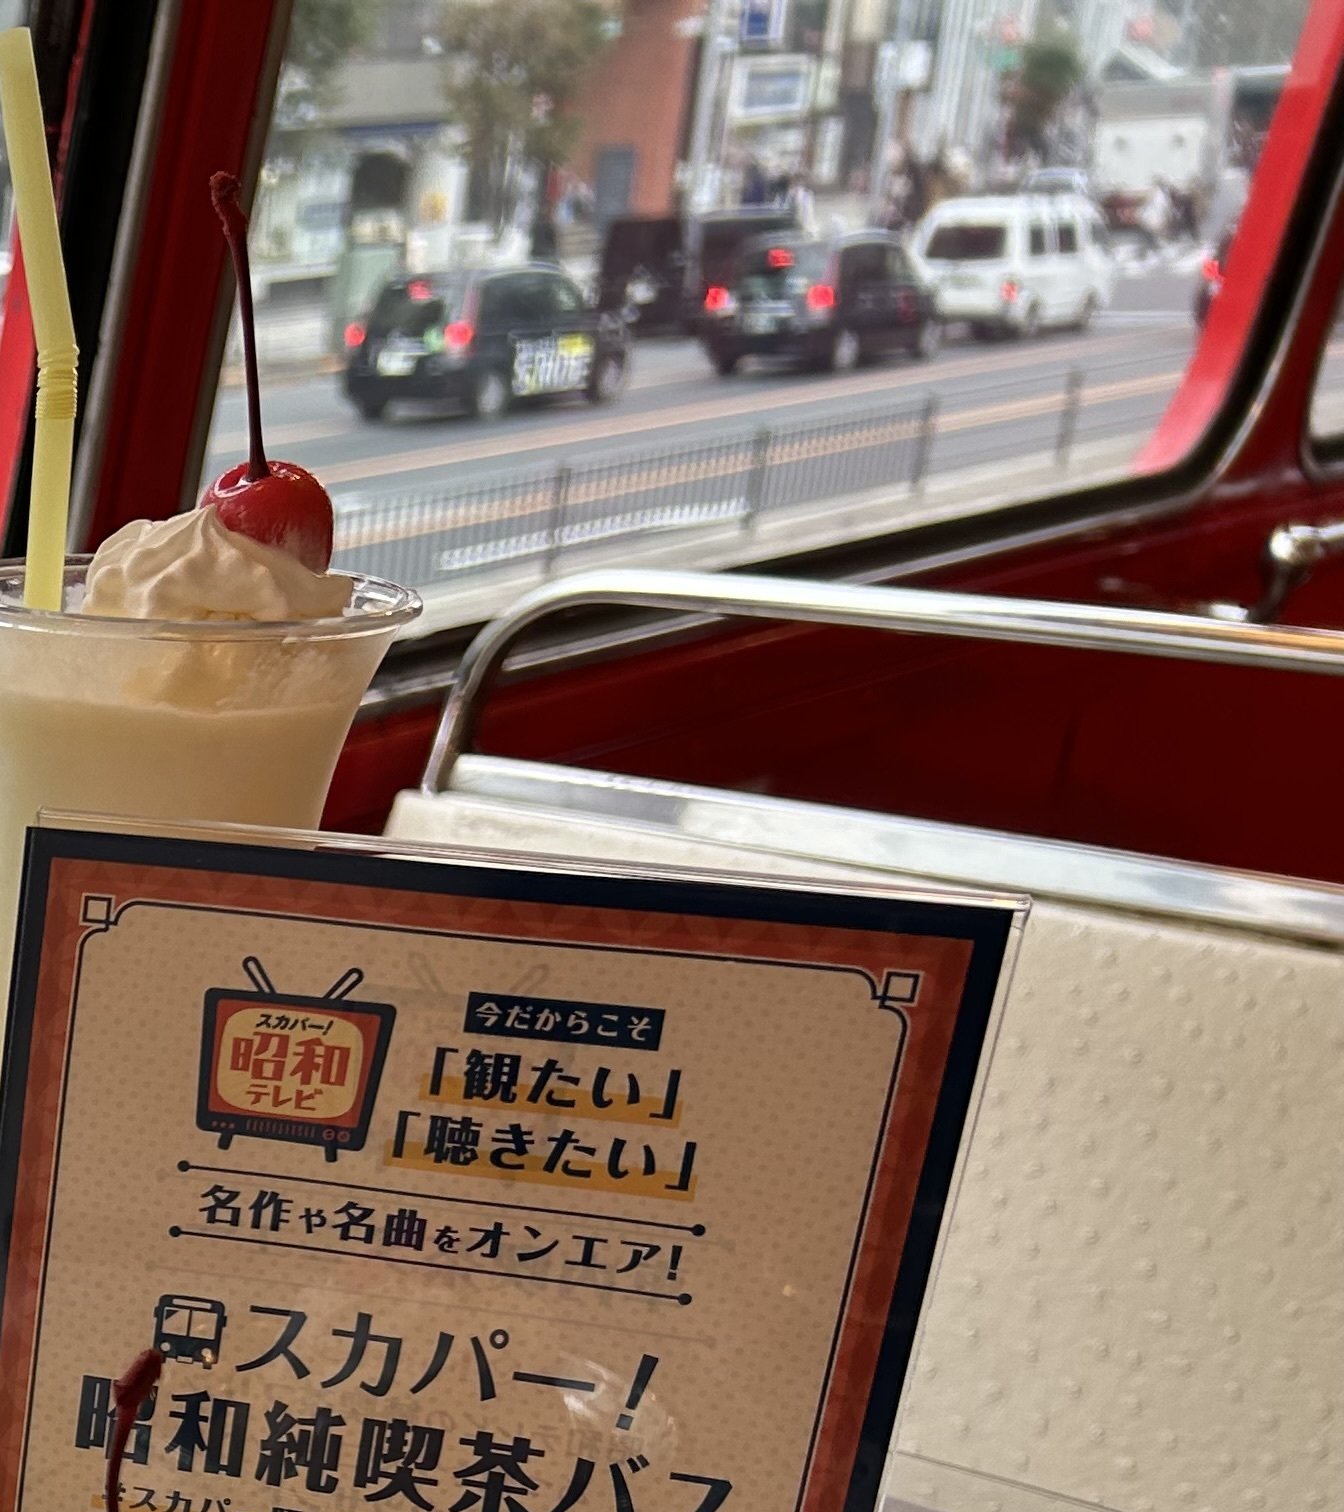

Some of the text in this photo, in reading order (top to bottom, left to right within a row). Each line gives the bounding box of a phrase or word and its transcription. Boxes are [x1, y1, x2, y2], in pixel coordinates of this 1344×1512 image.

[230, 1031, 352, 1087] 昭和
[473, 1001, 653, 1042] 今だからこそ
[245, 1084, 324, 1112] テレビ
[428, 1046, 683, 1121] 「観たい」
[391, 1109, 697, 1192] 「聴きたい」
[198, 1184, 684, 1281] 名作や名曲をオンエア!
[235, 1304, 659, 1431] スカパー!
